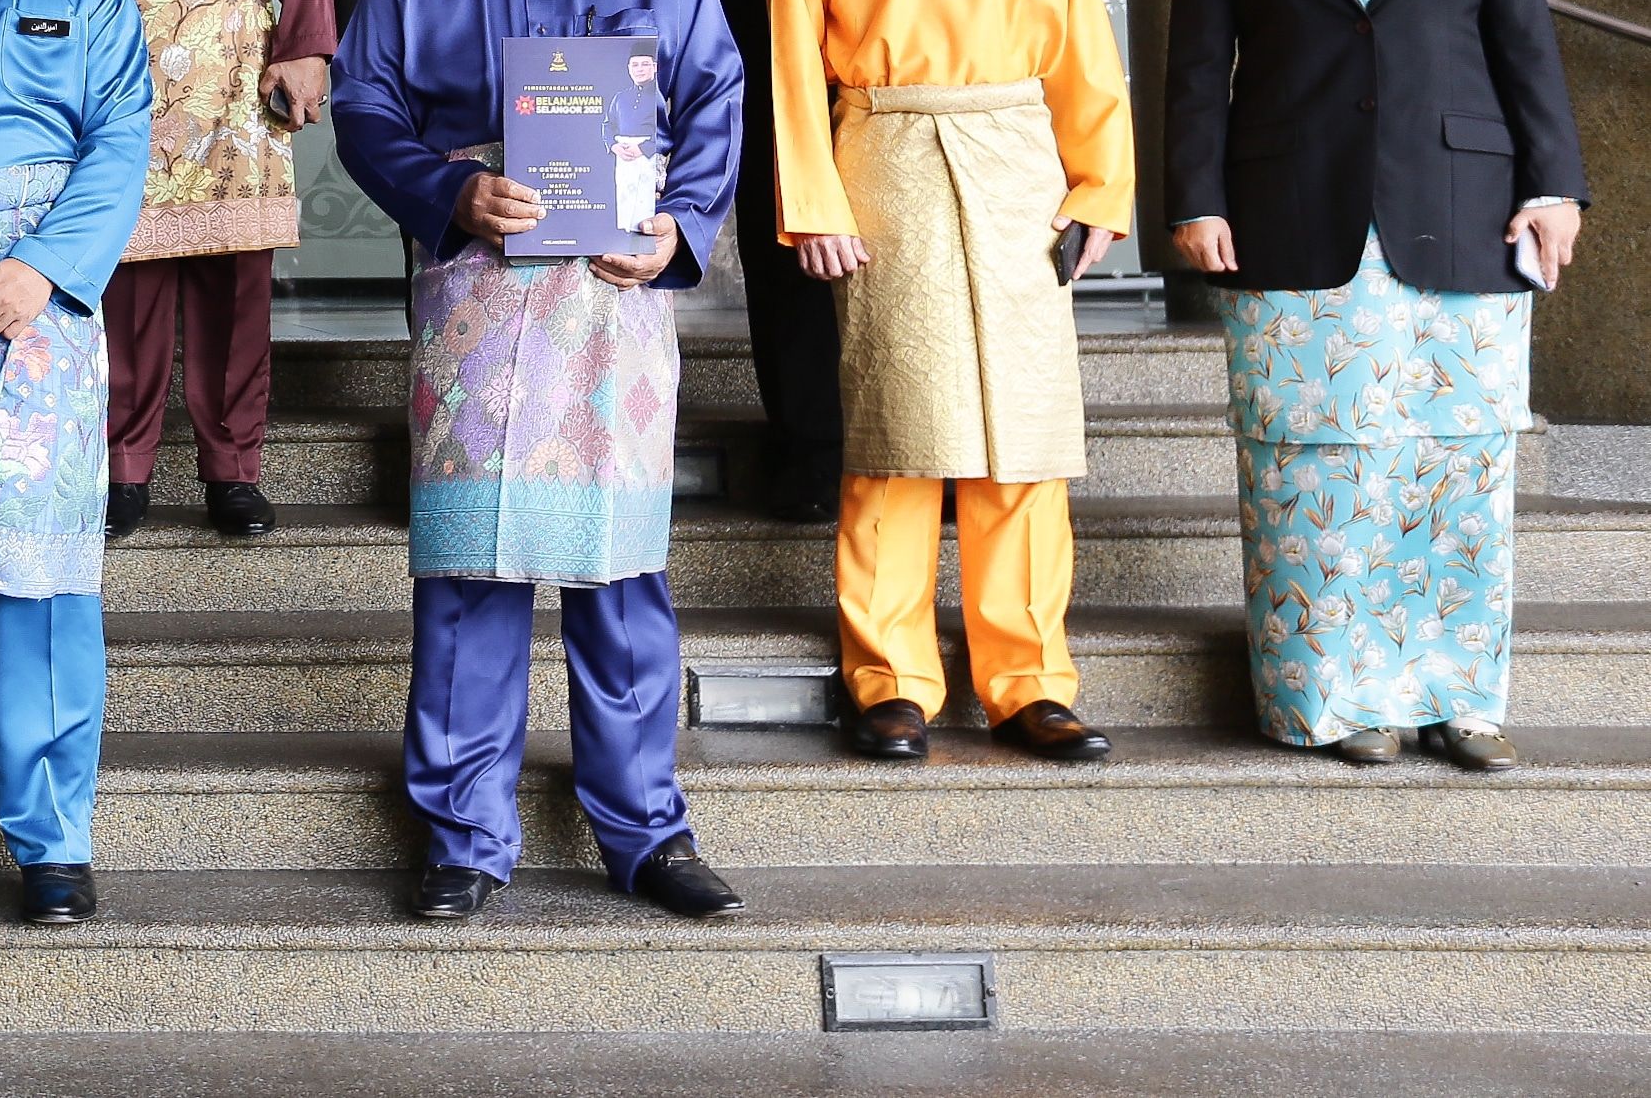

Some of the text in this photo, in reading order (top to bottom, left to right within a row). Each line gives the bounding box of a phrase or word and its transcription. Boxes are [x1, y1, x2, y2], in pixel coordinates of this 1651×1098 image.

[535, 96, 602, 106] BELANJAWAN
[536, 105, 603, 114] SELANGOR 2021
